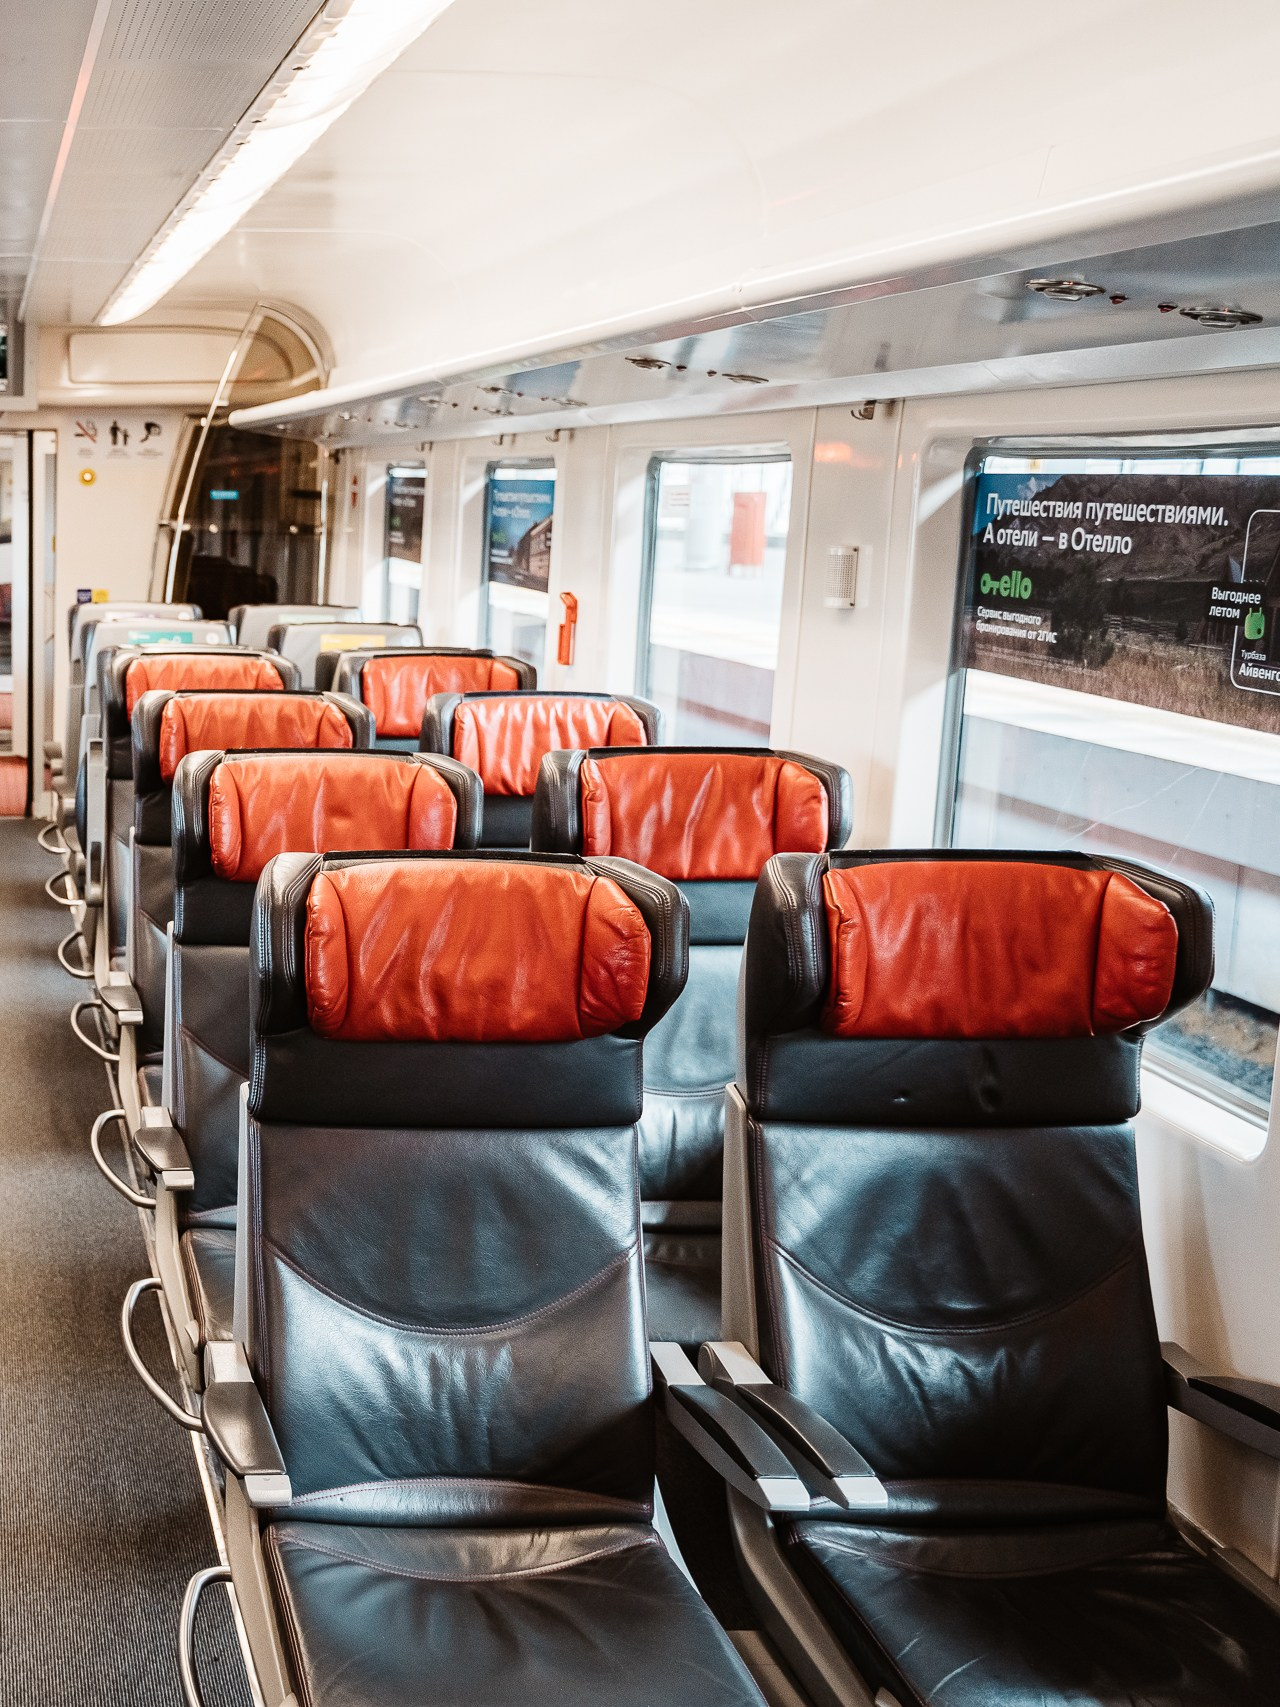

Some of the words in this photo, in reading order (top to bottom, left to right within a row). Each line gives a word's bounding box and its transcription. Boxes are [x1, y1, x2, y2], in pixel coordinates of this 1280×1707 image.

[986, 492, 1083, 521] Путешествия
[1085, 502, 1229, 527] путешествиями.
[982, 522, 995, 544] А
[996, 528, 1039, 548] отели
[1058, 532, 1068, 550] в
[1071, 526, 1132, 555] Отелло
[1211, 586, 1262, 605] Выгоднее
[977, 605, 1002, 619] Сервис
[1002, 611, 1042, 626] выгодного
[1208, 605, 1240, 619] летом
[1027, 630, 1038, 640] от
[1037, 629, 1058, 644] 2ГИС
[1241, 649, 1267, 661] Турбаза
